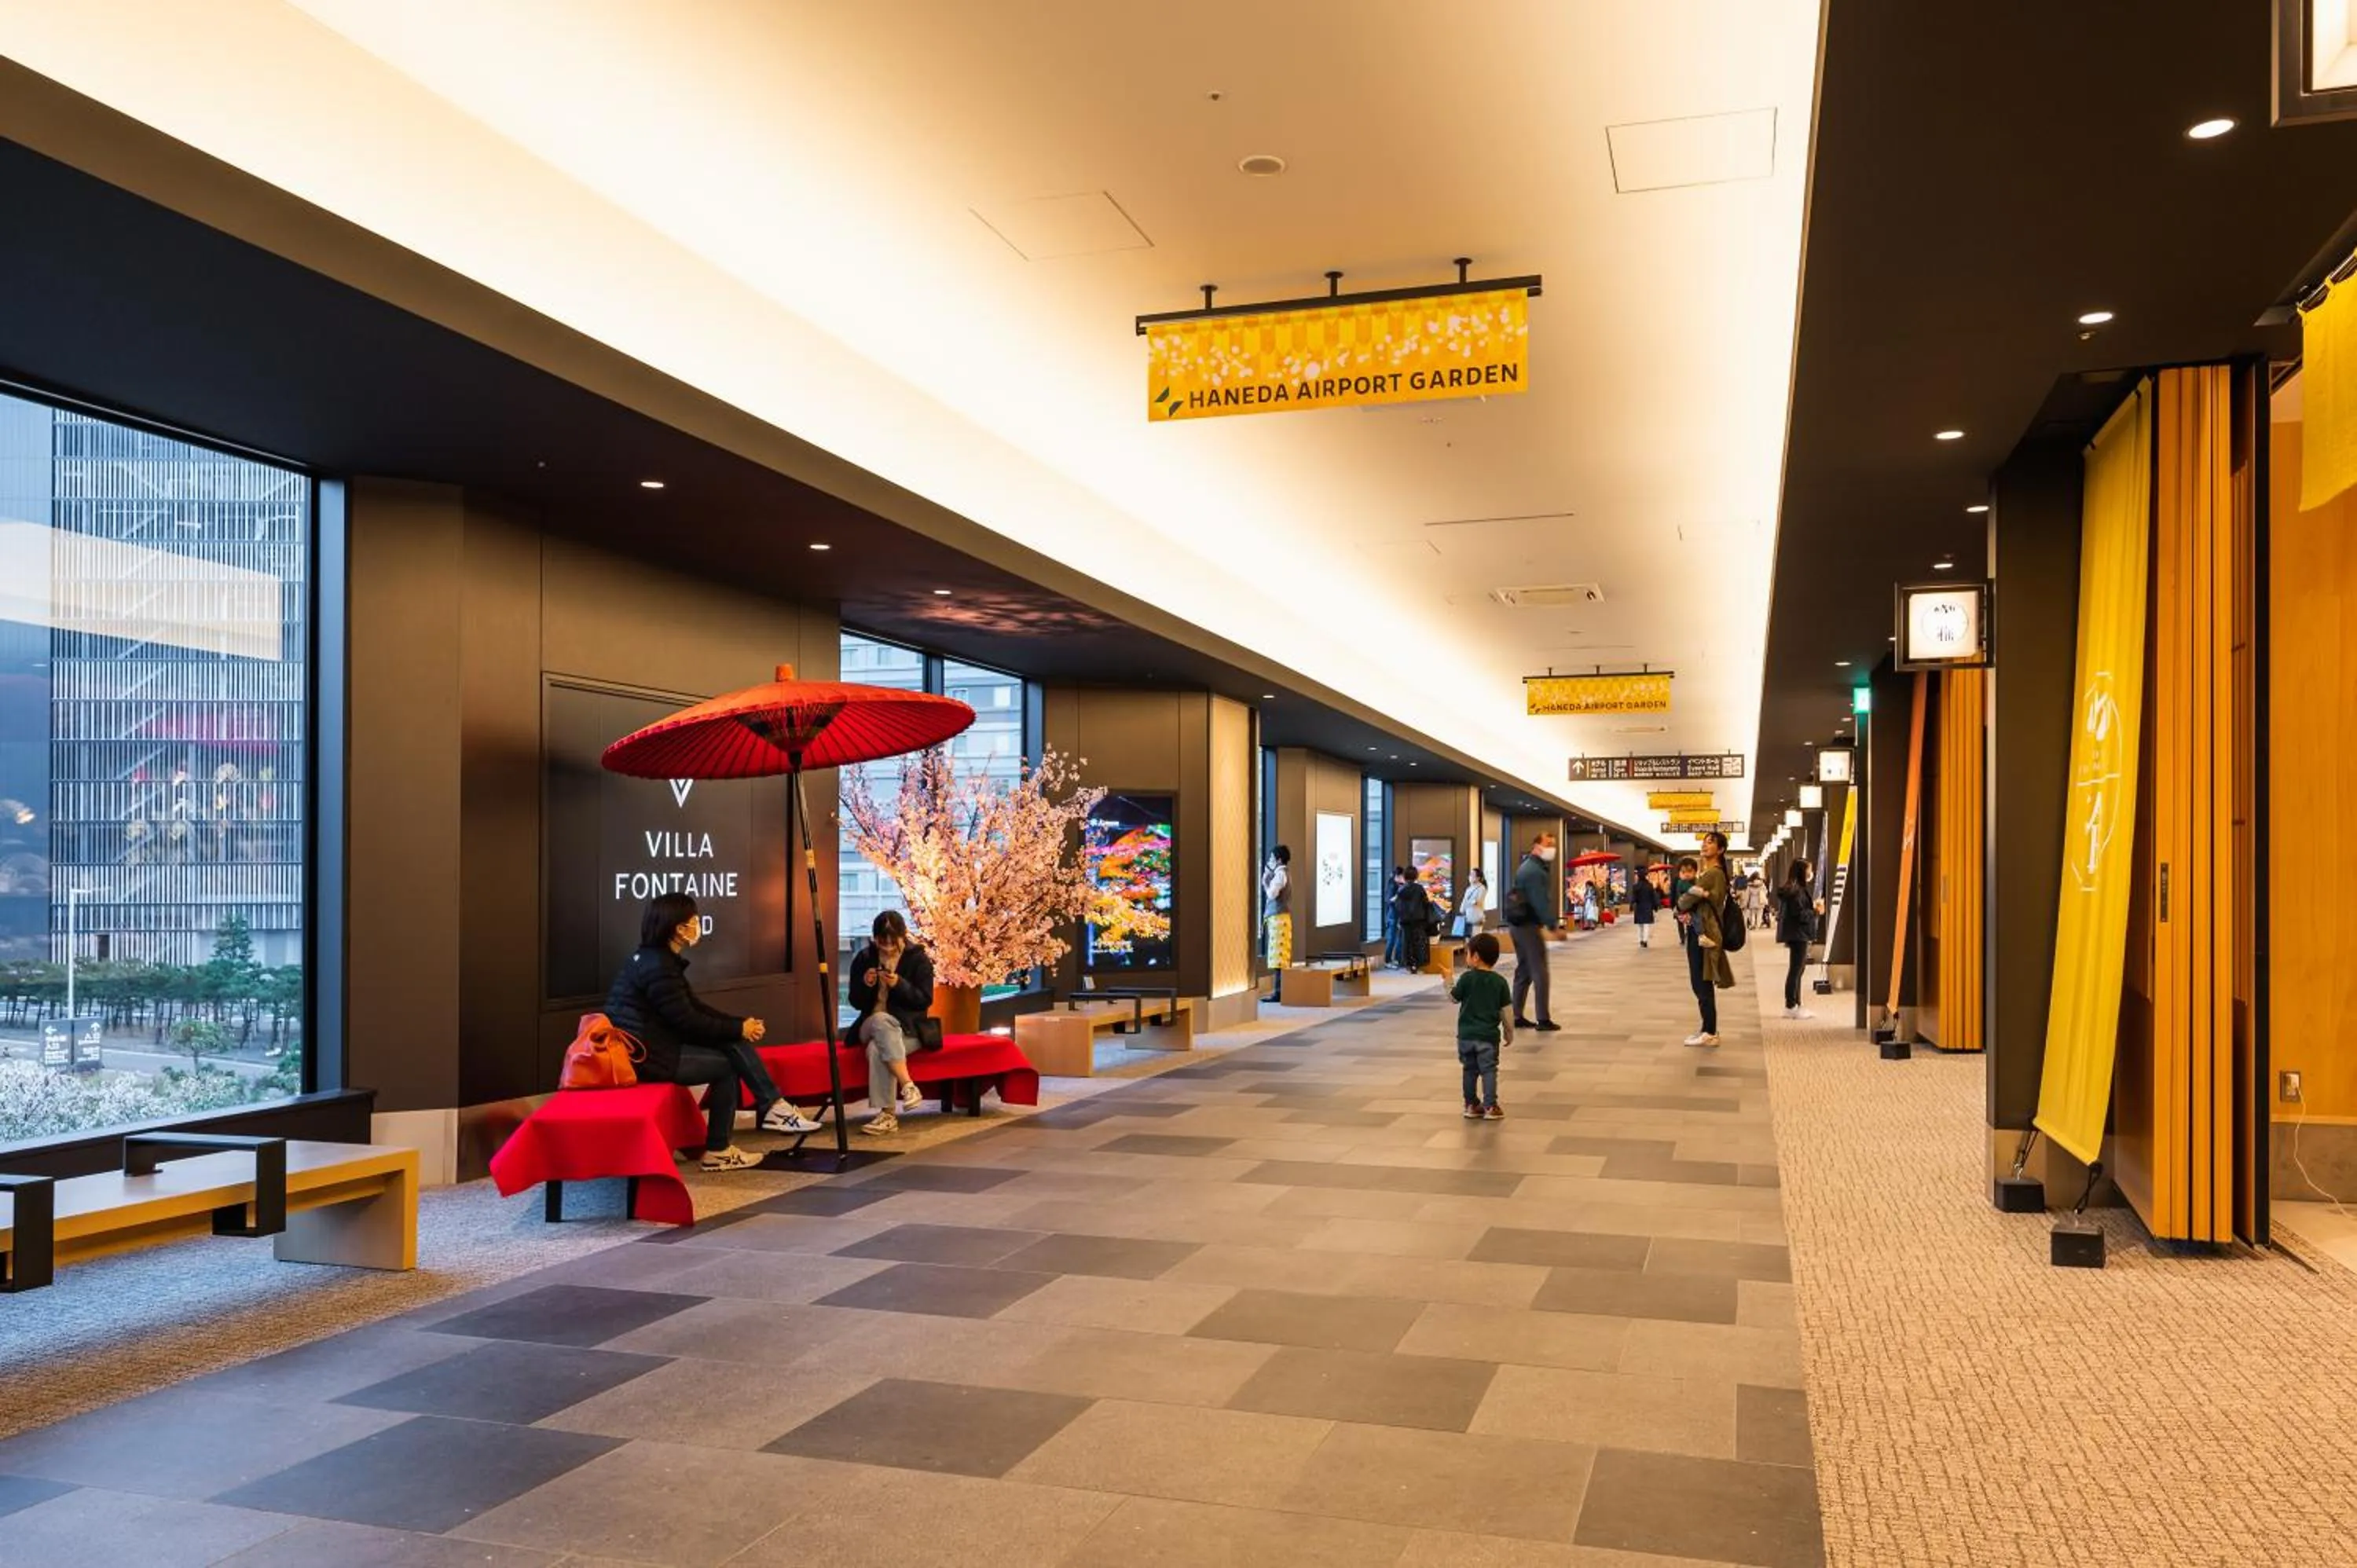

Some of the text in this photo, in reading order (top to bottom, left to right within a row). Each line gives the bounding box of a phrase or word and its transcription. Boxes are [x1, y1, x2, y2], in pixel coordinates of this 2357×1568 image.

[1189, 363, 1518, 409] HANEDA AIRPORT GARDEN
[1582, 702, 1623, 710] AIRPORT
[645, 830, 713, 858] VILLA
[615, 873, 738, 899] FONTAINE
